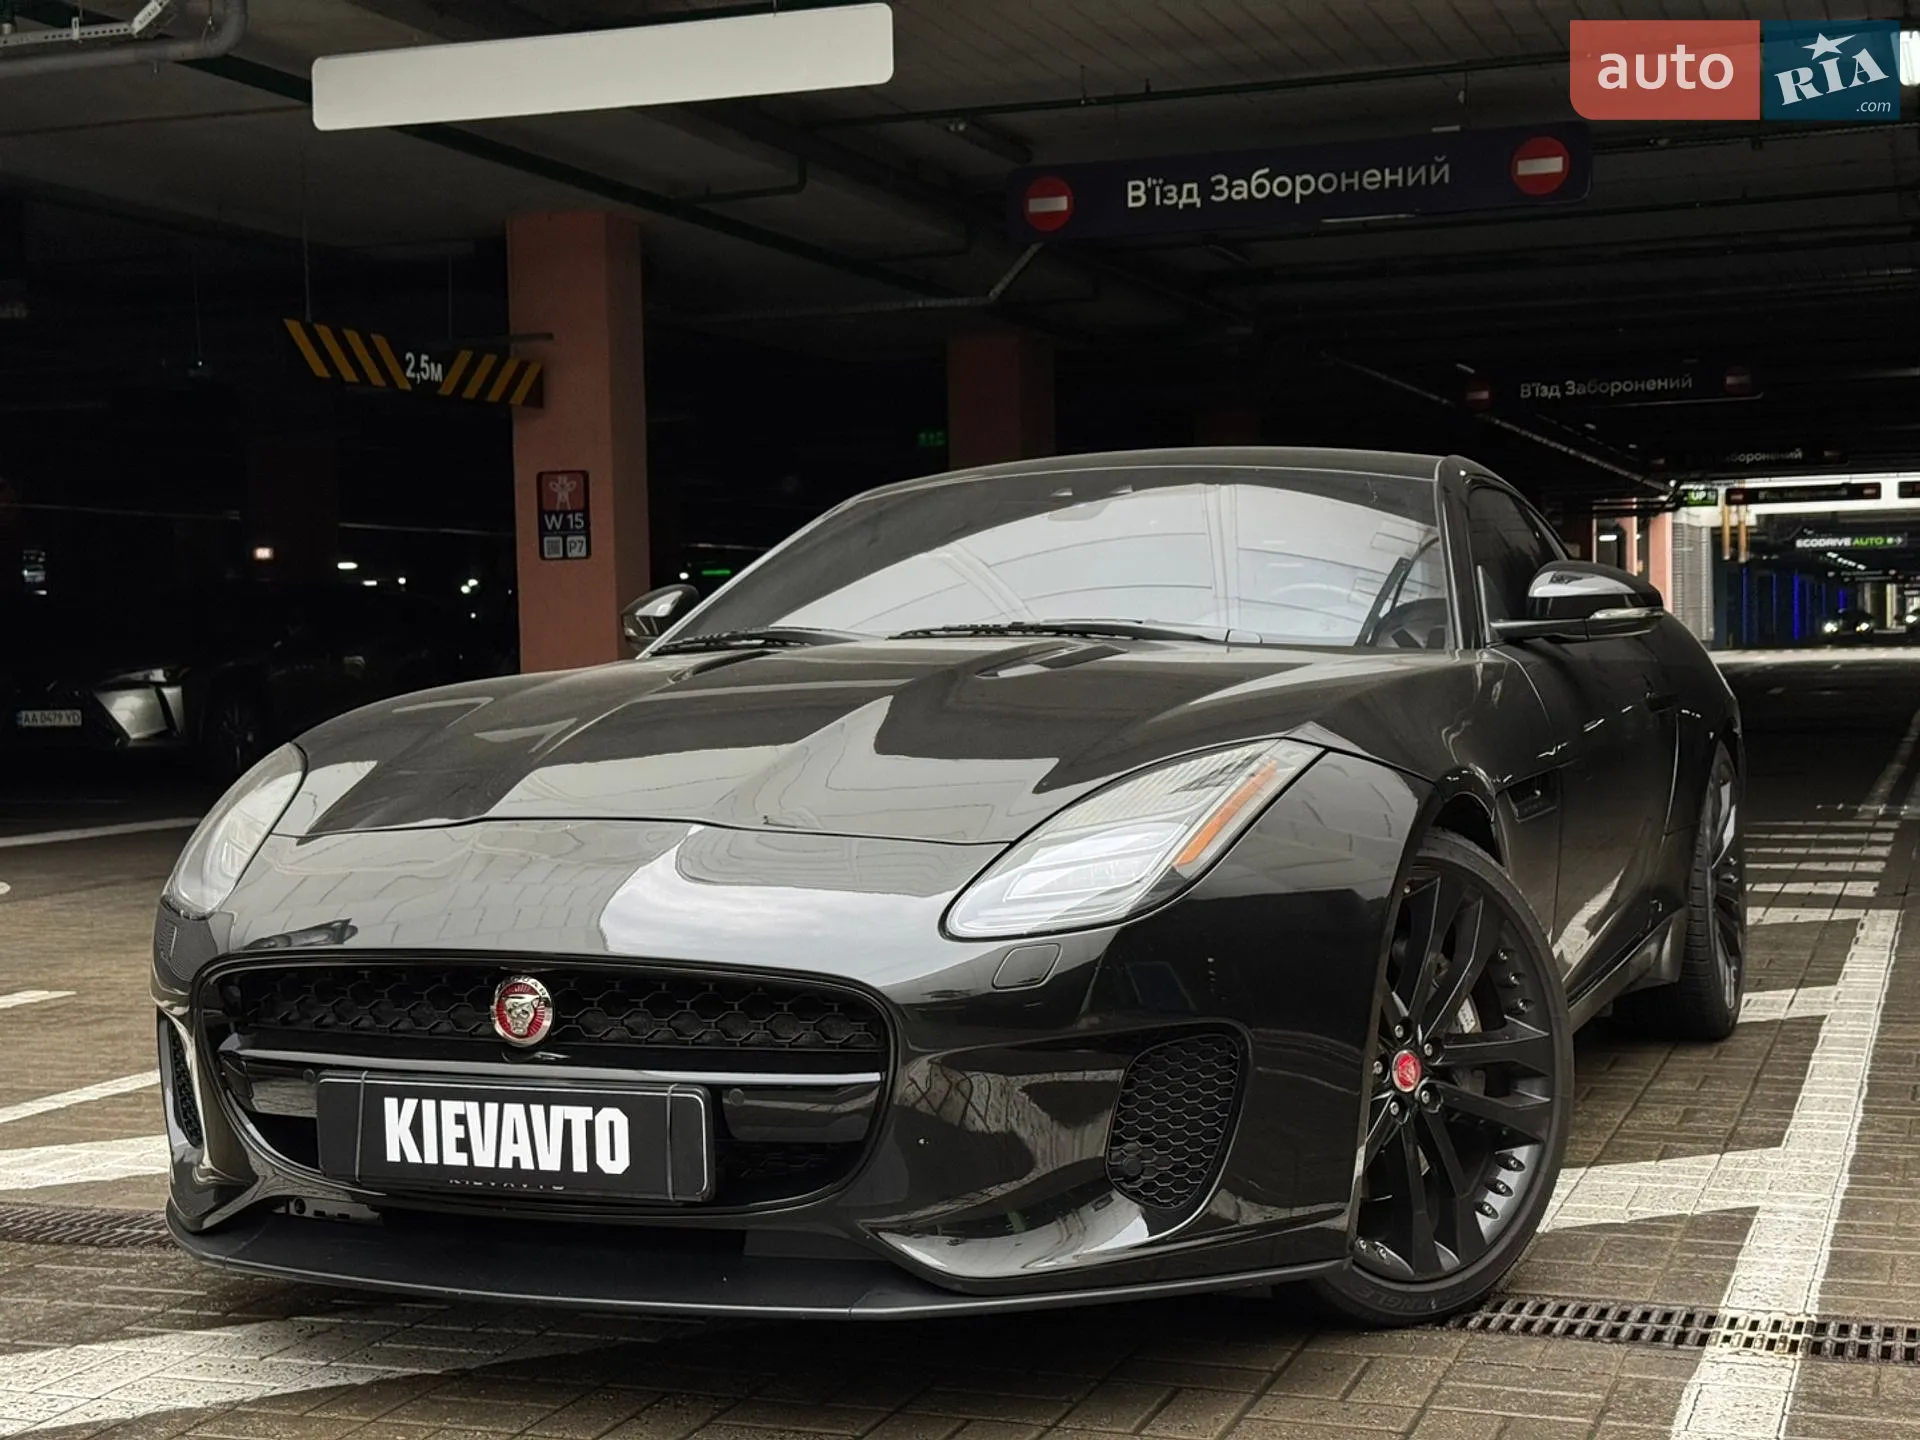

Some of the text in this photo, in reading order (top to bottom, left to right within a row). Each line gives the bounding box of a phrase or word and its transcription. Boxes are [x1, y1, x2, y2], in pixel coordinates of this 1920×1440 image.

[1126, 155, 1451, 210] В'їзд Заборонений
[1519, 372, 1692, 400] В'їзд Заборонений
[544, 511, 585, 531] W 15
[1853, 536, 1884, 546] AUTO
[384, 1097, 631, 1175] KIEVAVTO
